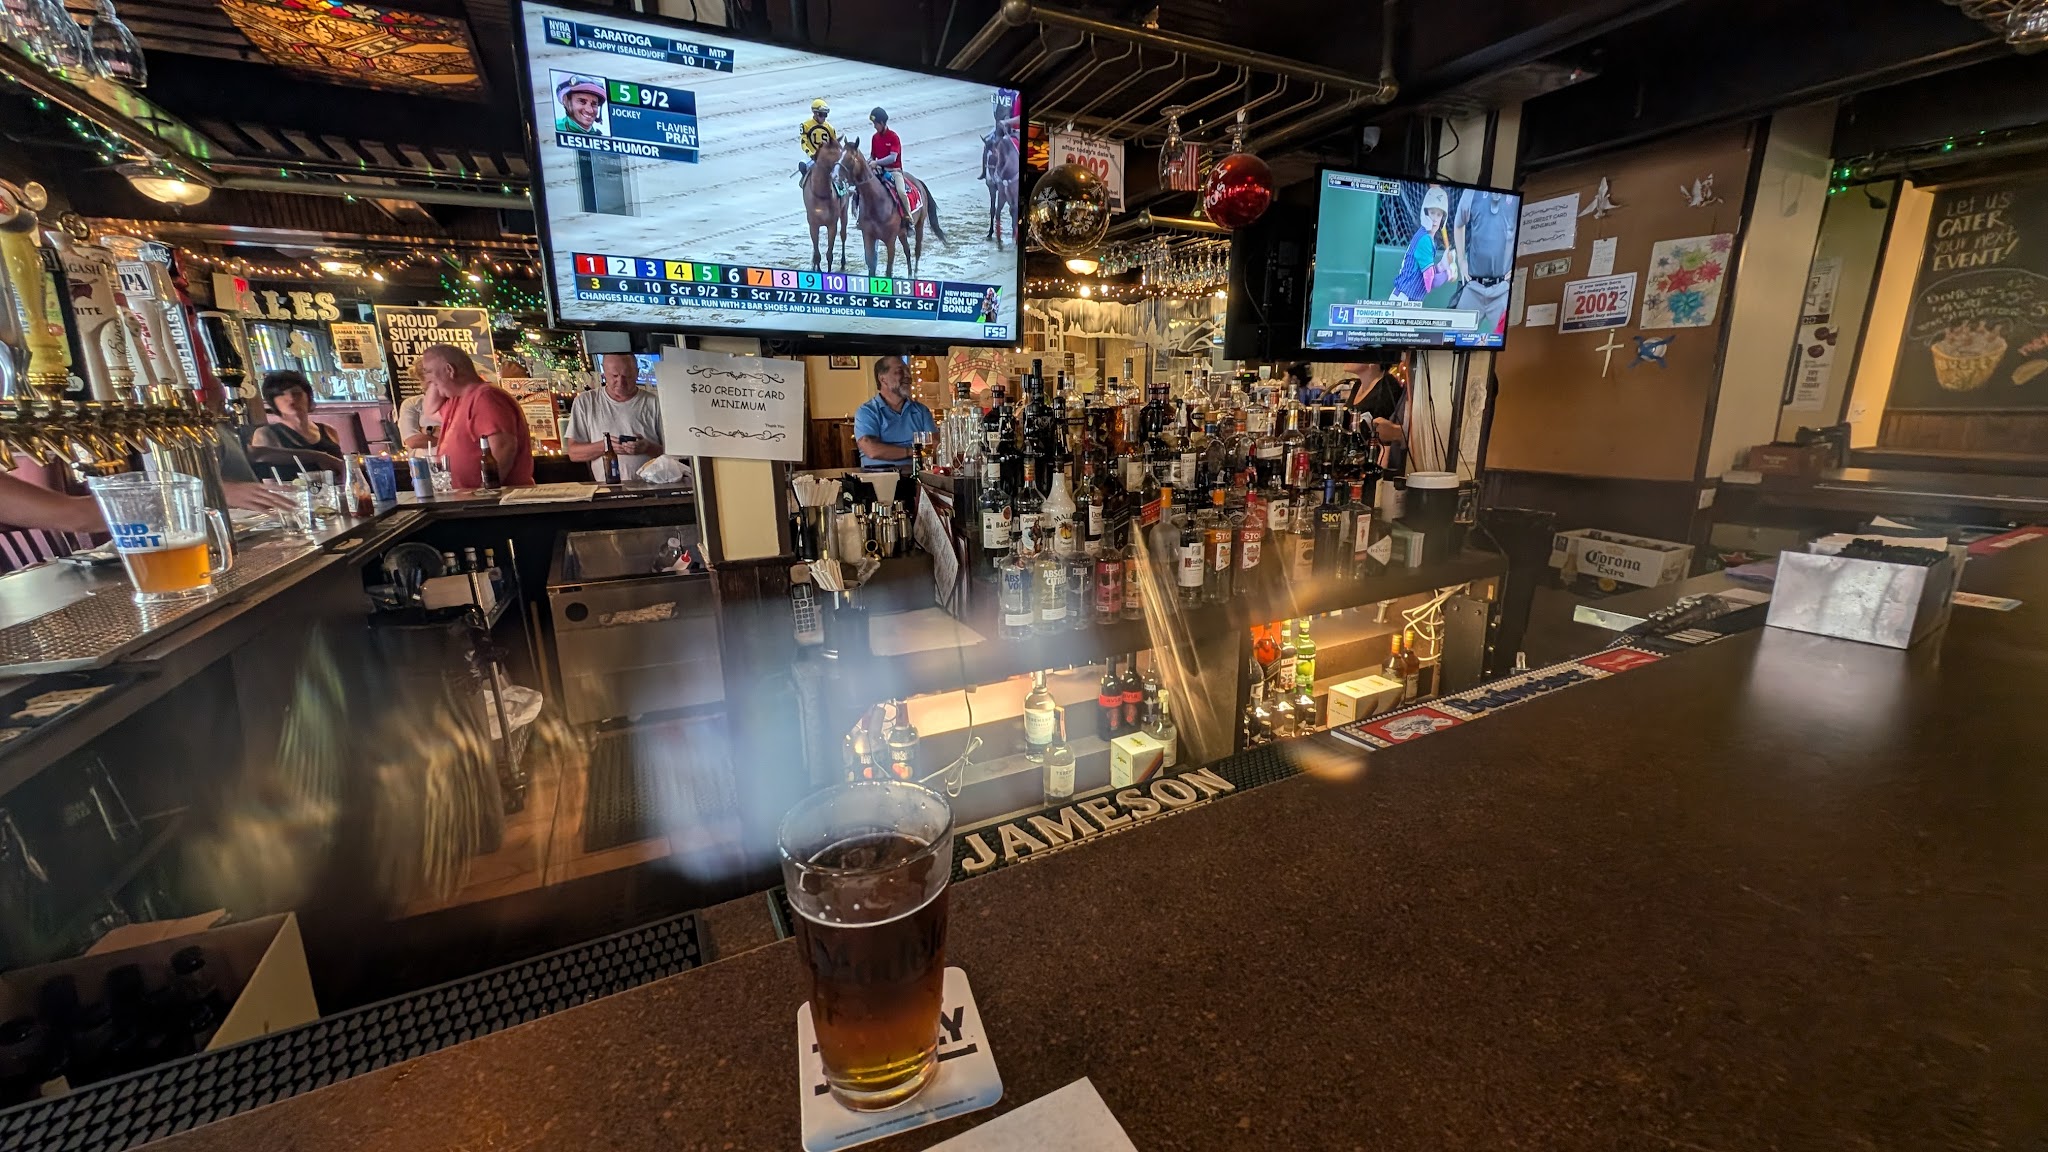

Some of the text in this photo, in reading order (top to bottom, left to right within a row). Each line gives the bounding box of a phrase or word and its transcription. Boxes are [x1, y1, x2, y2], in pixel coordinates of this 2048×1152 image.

[549, 20, 571, 33] NYRA
[550, 29, 571, 39] BETS
[593, 28, 652, 47] SARATOGA
[587, 40, 616, 52] SLOPPY
[676, 42, 727, 59] RACE MTP
[683, 55, 695, 66] 10
[714, 61, 721, 70] 7
[619, 85, 669, 108] 5 9/2
[990, 94, 1012, 107] LIVE
[612, 107, 641, 120] JOCKEY
[656, 121, 696, 134] FLAVIEN
[665, 132, 696, 146] PRAT
[1073, 138, 1110, 150] you were born
[560, 134, 660, 158] LESLIE'S HUMOR
[1062, 144, 1075, 152] after
[1076, 146, 1095, 155] today's
[1936, 209, 2007, 239] CATER
[1932, 236, 2020, 272] EVENT!
[586, 256, 933, 297] 1 2 3 4 5 6 7 8 9 10 11 12 13 14
[591, 277, 934, 311] 3 6 10 Scr 9/2 5 Scr 7/2 7/2 Scr Scr Scr Scr Scr
[959, 291, 984, 299] MEMBER
[236, 290, 341, 321] ALES
[580, 292, 621, 302] CHANGES
[622, 293, 645, 303] RACE
[648, 296, 659, 304] 10
[668, 296, 676, 306] 6
[680, 298, 700, 307] WILL
[701, 299, 718, 308] RUN
[720, 300, 740, 309] WITH
[747, 302, 763, 310] BAR
[764, 304, 788, 312] SHOES
[789, 305, 805, 313] AND
[812, 306, 831, 315] HIND
[831, 307, 854, 316] SHOES
[943, 297, 978, 306] SIGN UP
[1574, 291, 1618, 315] 2002
[942, 304, 973, 314] BONUS
[387, 314, 438, 328] PROUD
[390, 328, 474, 341] SUPPORTER
[985, 326, 1007, 338] FS2
[1366, 331, 1384, 339] champion
[392, 341, 411, 354] OF
[177, 348, 198, 388] LAGER
[691, 383, 785, 400] $20 CREDIT CARD
[711, 398, 766, 411] MINIMUM
[1585, 549, 1641, 572] Corona
[1597, 564, 1625, 578] Extra
[961, 767, 1236, 873] JAMESON
